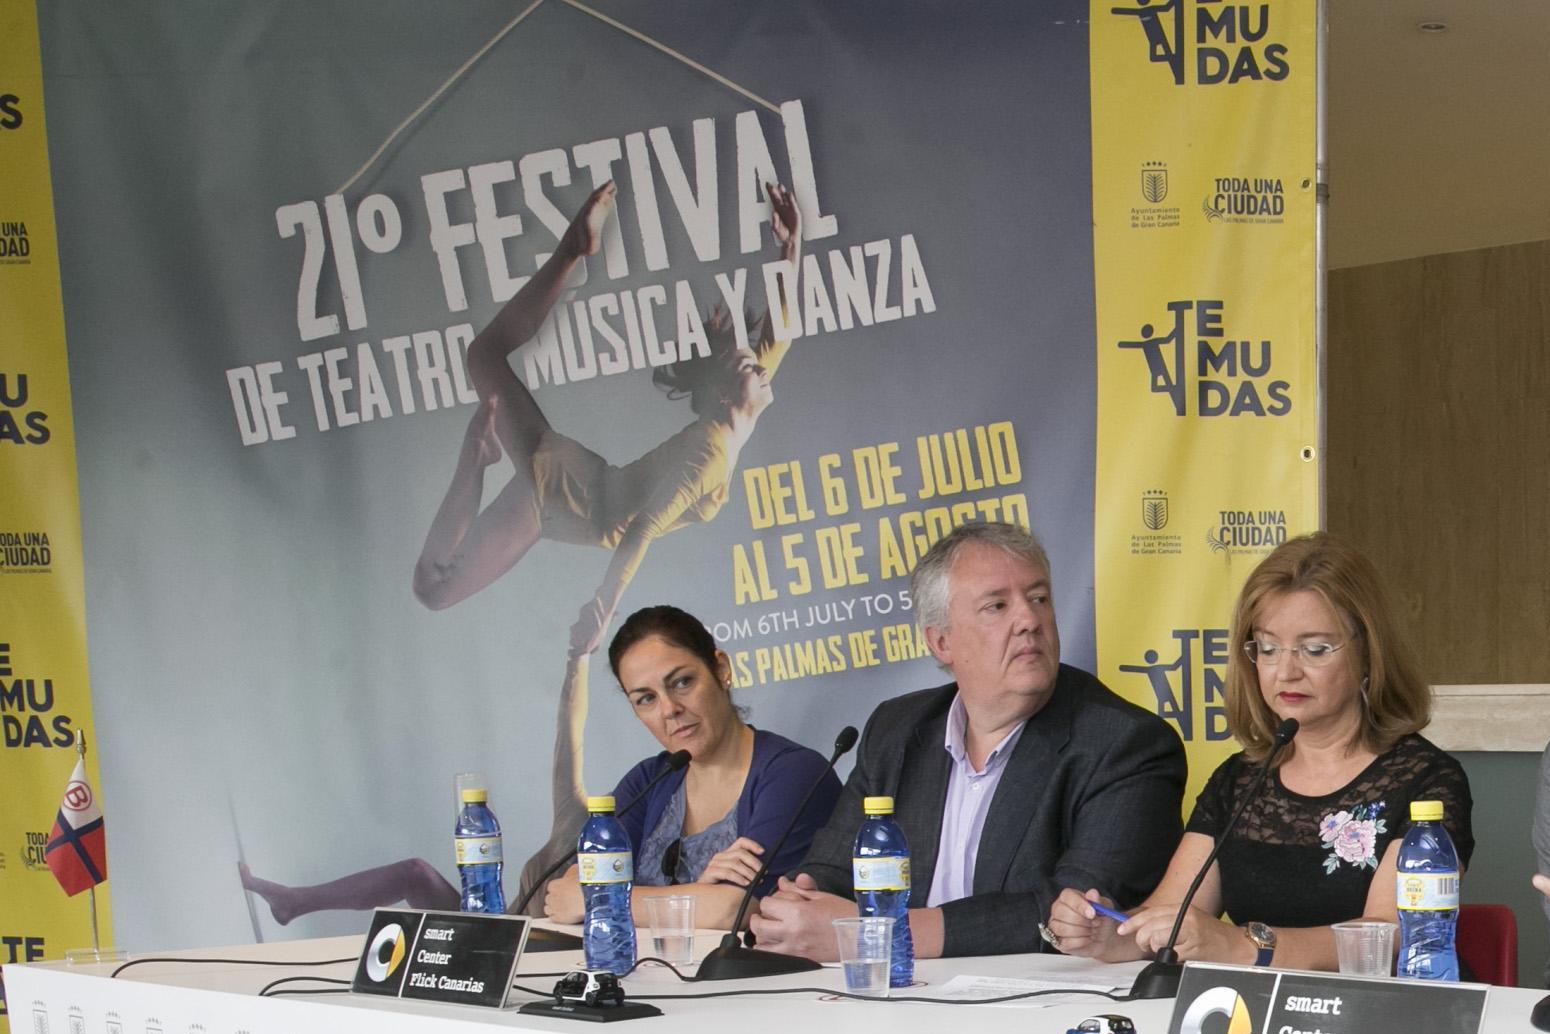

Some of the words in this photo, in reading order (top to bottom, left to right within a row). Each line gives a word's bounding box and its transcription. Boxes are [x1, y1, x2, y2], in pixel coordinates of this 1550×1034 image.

[1196, 5, 1268, 43] MU
[1197, 44, 1289, 84] DAS
[1215, 178, 1250, 193] TODA
[1254, 179, 1283, 193] UNA
[421, 99, 838, 312] FESTIVAL
[1214, 194, 1284, 216] CIUDAD
[226, 361, 296, 447] DE
[297, 322, 481, 432] TEATRO
[715, 268, 748, 351] Y
[762, 233, 937, 342] DANZA
[1198, 340, 1271, 377] MU
[0, 373, 28, 408] U
[1198, 380, 1292, 416] DAS
[0, 411, 50, 445] AS
[743, 460, 815, 530] DEL
[819, 453, 849, 516] 6
[853, 442, 906, 510] DE
[917, 421, 1022, 499] JULIO
[1219, 511, 1255, 525] TODA
[1258, 511, 1286, 525] UNA
[0, 533, 21, 546] ODA
[24, 533, 50, 546] UNA
[1219, 526, 1287, 546] CIUDAD
[732, 540, 778, 606] AL
[782, 534, 812, 596] 5
[815, 523, 869, 589] DE
[758, 612, 799, 636] 6TH
[805, 600, 858, 626] JULY
[861, 594, 894, 616] TO
[757, 635, 846, 685] PALMAS
[848, 628, 880, 667] DE
[883, 623, 932, 663] GRA
[2, 715, 75, 748] DAS
[424, 927, 454, 941] smart
[417, 949, 451, 965] Center
[409, 973, 437, 988] Flick
[438, 977, 484, 994] Canarias
[1285, 995, 1343, 1015] smart
